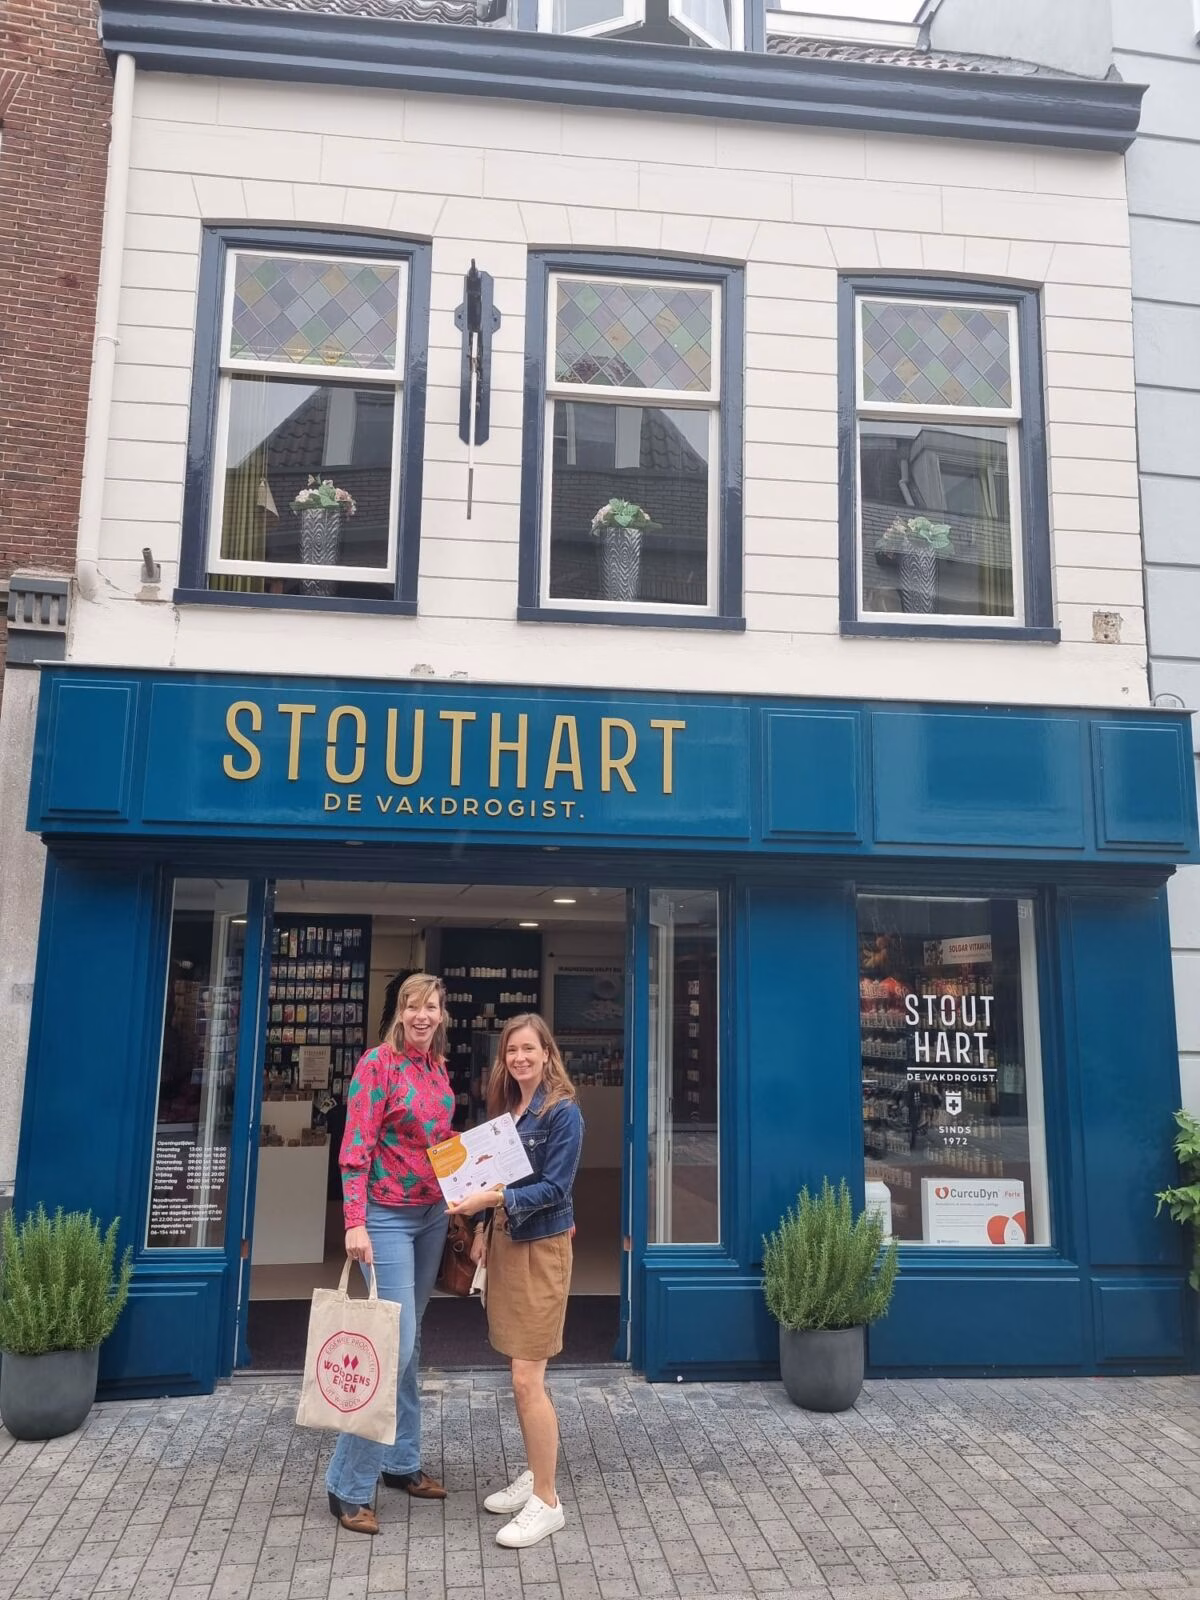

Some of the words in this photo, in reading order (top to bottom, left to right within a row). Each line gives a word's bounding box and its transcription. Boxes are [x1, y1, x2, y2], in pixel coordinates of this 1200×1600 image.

[222, 700, 686, 794] STOUTHART
[324, 793, 362, 812] DE
[376, 795, 585, 819] VAKDROGIST.
[905, 994, 994, 1027] STOUT
[914, 1031, 988, 1064] HART
[907, 1073, 921, 1081] DE
[925, 1073, 998, 1083] VAKDROGIST.
[938, 1126, 971, 1134] SINDS
[943, 1137, 968, 1146] 1972
[950, 1188, 999, 1200] CurcuDyn
[1004, 1190, 1021, 1198] Forte
